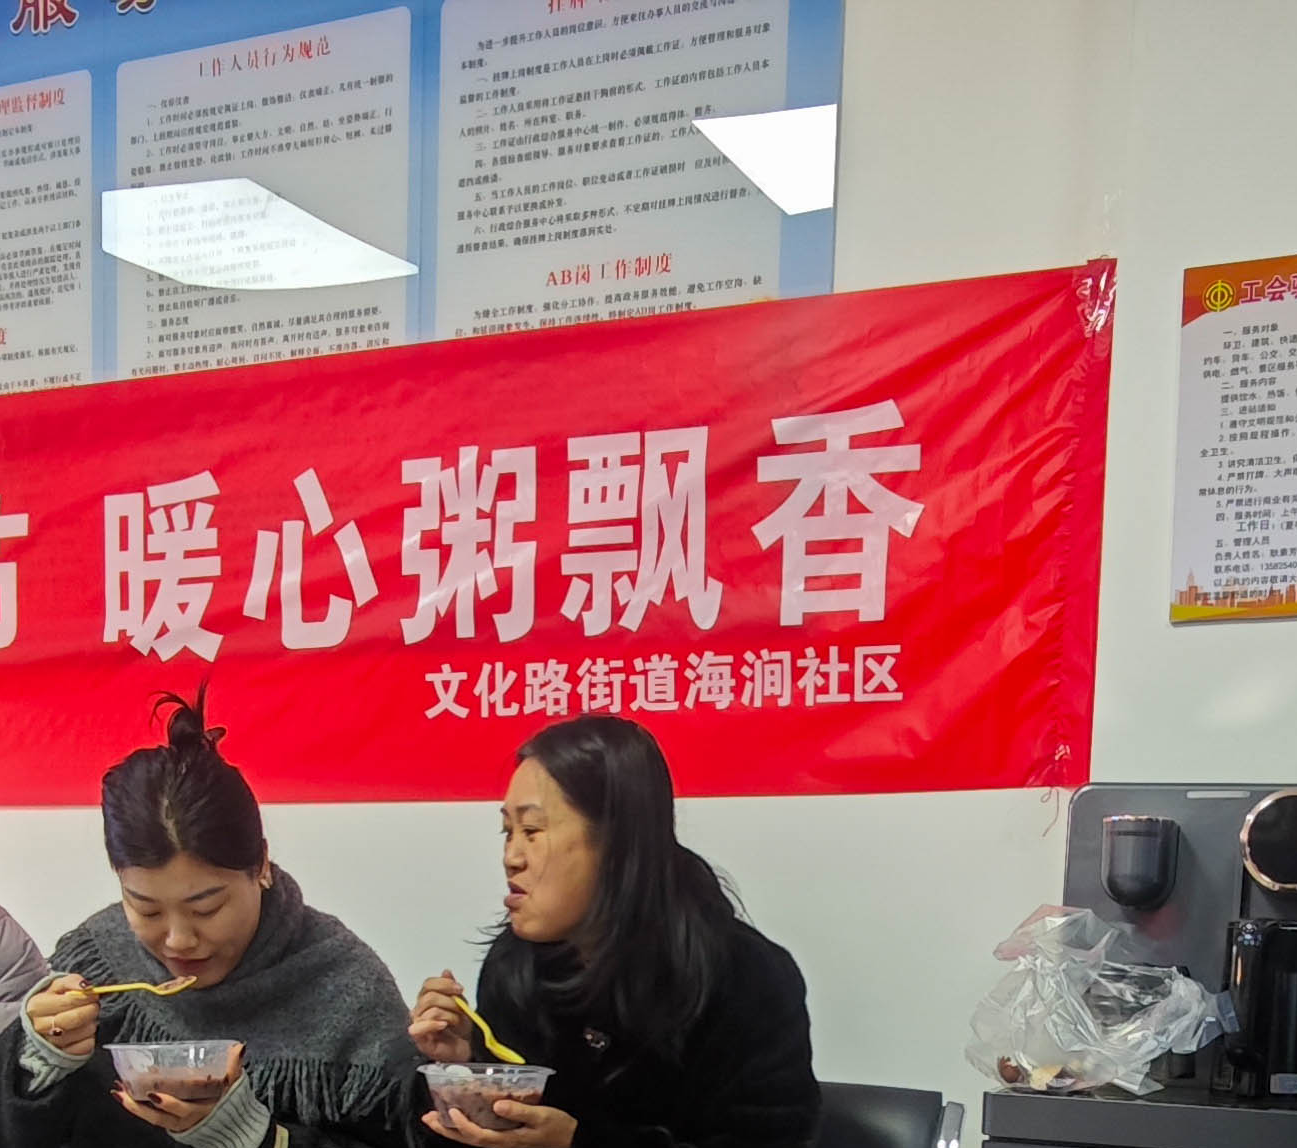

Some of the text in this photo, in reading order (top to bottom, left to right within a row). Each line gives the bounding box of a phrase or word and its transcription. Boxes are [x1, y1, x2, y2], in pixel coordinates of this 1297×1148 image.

[199, 34, 332, 80] 工作人员行为规范
[545, 252, 672, 288] AB岗工作制度
[101, 397, 927, 665] 暖心粥飘香
[424, 645, 906, 721] 文化路街道海涧社区
